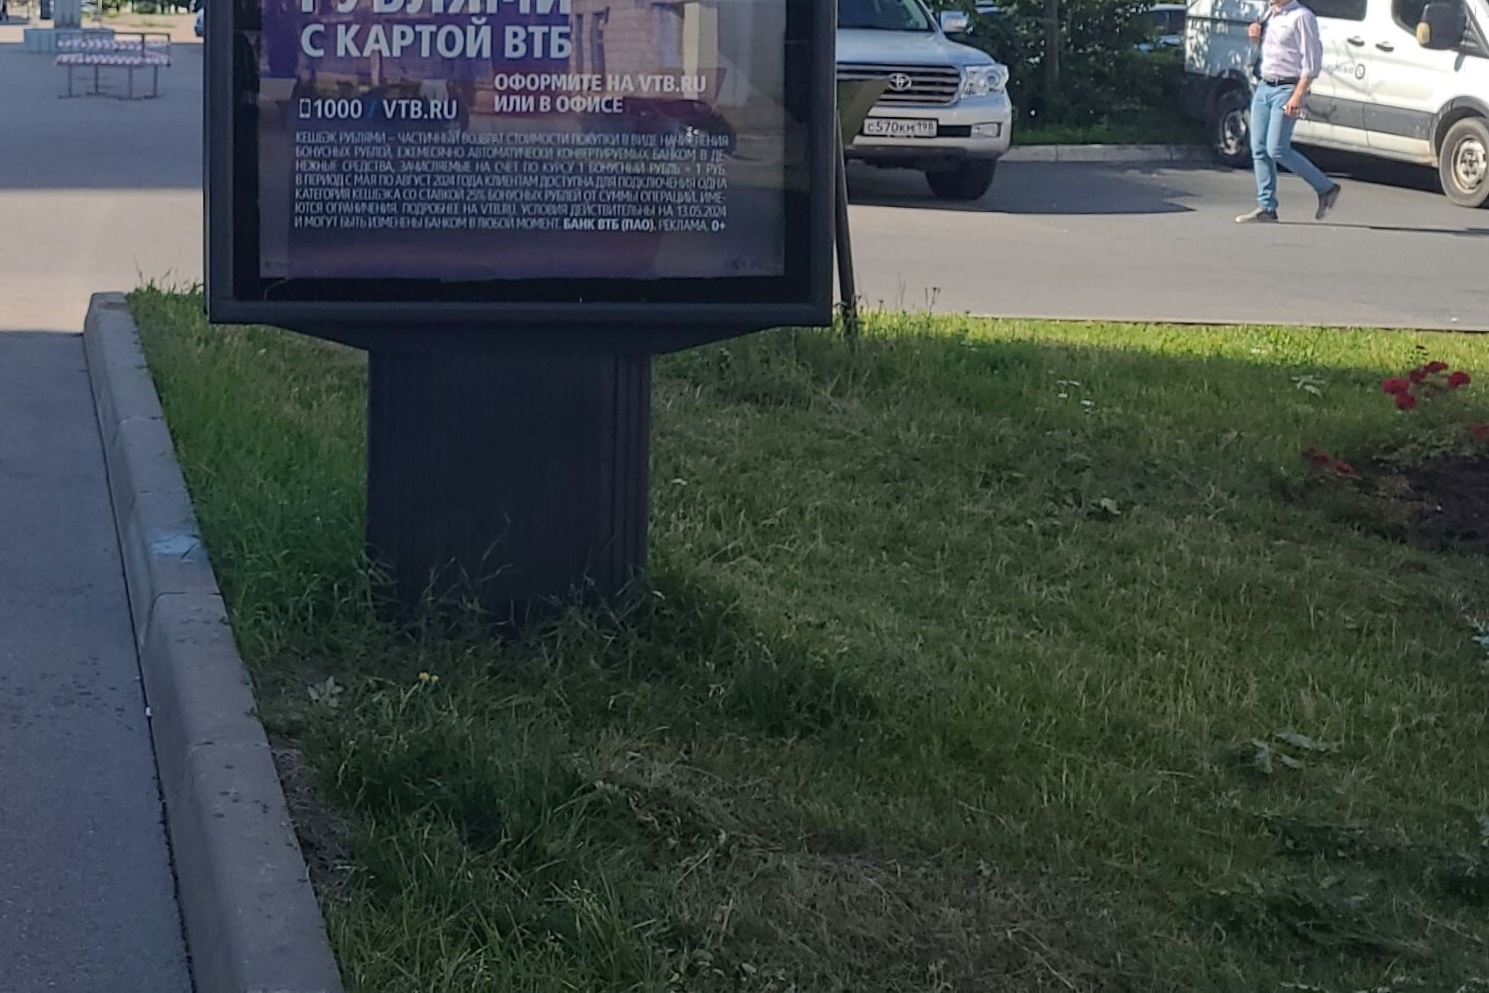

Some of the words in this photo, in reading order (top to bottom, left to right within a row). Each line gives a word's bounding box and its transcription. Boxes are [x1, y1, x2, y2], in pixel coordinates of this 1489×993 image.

[301, 24, 325, 57] С
[336, 17, 492, 58] КАРТОЙ
[504, 25, 573, 59] ВТБ
[494, 72, 602, 92] ОФОРМИТЕ
[606, 74, 635, 93] НА
[637, 74, 707, 94] VTB.RU
[313, 98, 362, 119] 1000
[382, 98, 458, 120] VTB.RU
[494, 95, 533, 113] ИЛИ
[539, 96, 551, 113] В
[555, 95, 623, 115] ОФИСЕ
[563, 218, 595, 230] БАНК
[597, 218, 619, 230] ВТБ
[621, 218, 656, 230] (ПАО).
[711, 219, 725, 230] 0+
